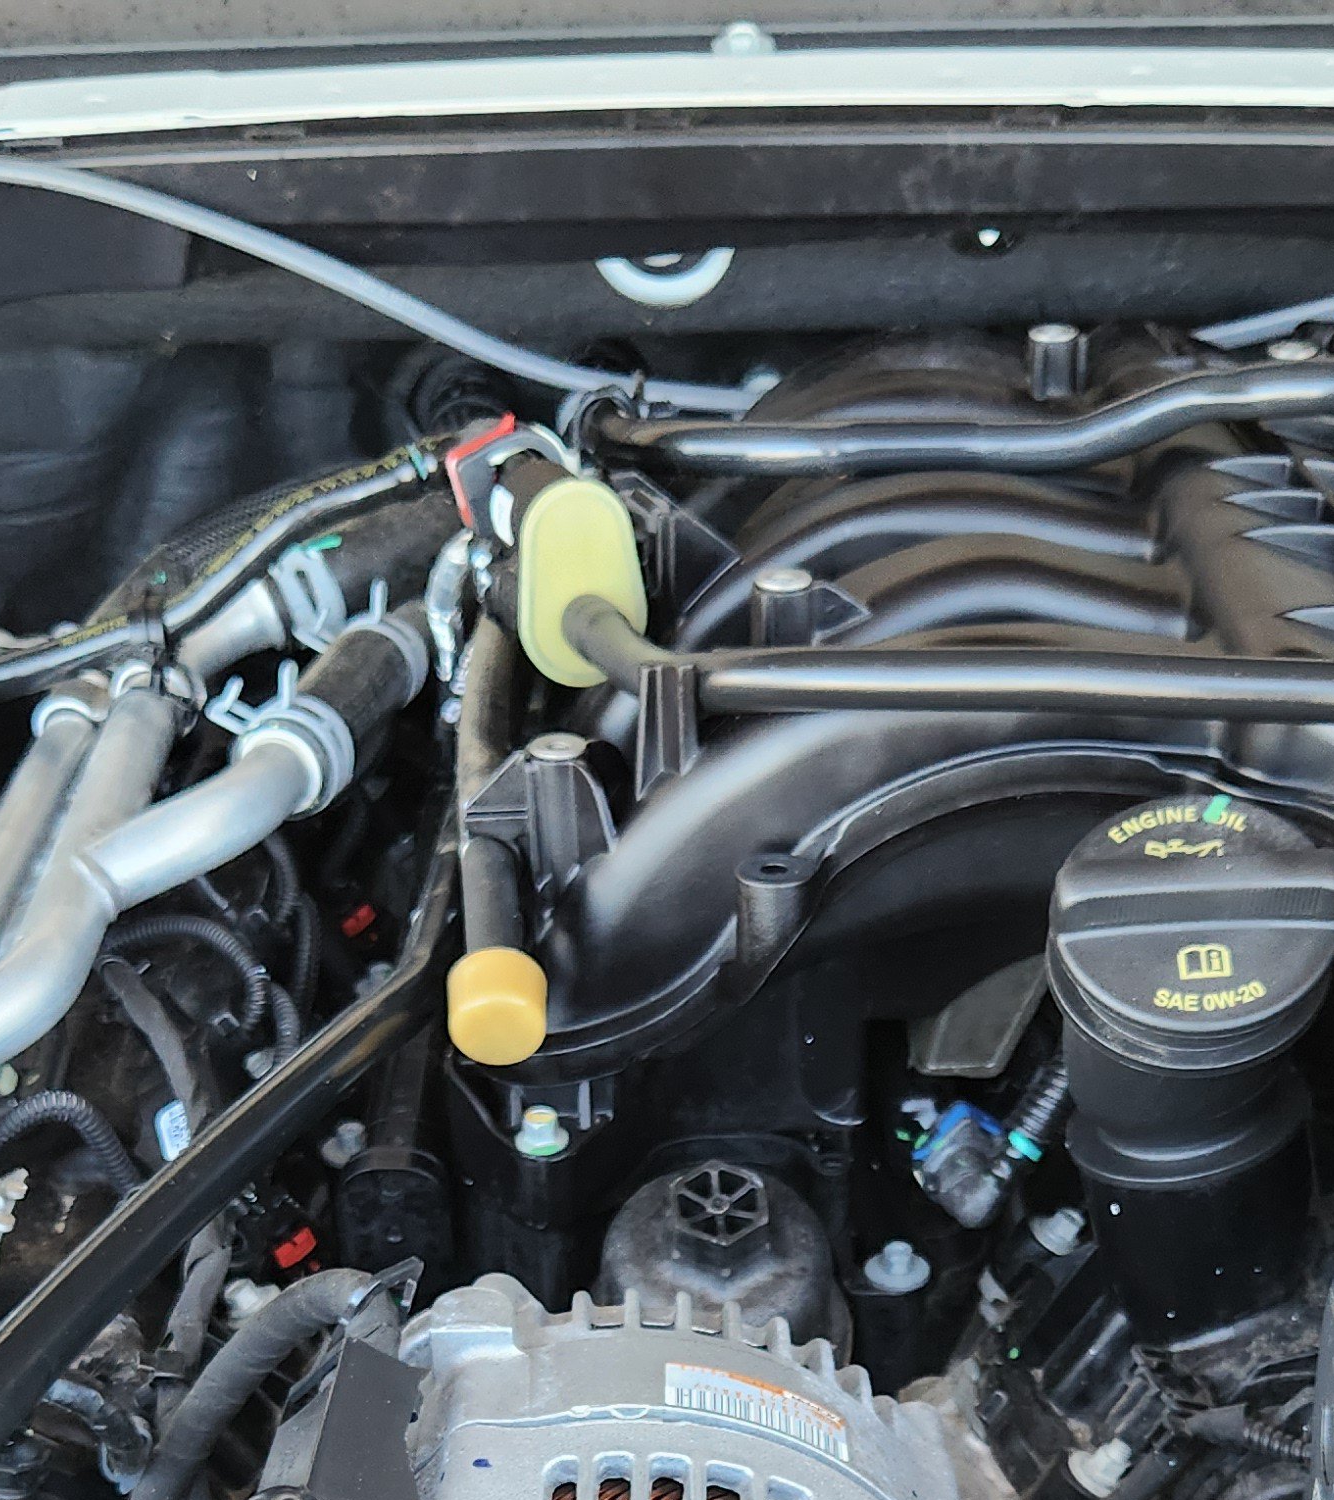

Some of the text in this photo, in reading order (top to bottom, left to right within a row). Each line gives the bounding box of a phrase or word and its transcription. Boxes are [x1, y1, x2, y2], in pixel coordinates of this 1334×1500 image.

[1108, 806, 1199, 845] ENGINE
[1153, 980, 1267, 1012] SAE 0W-20
